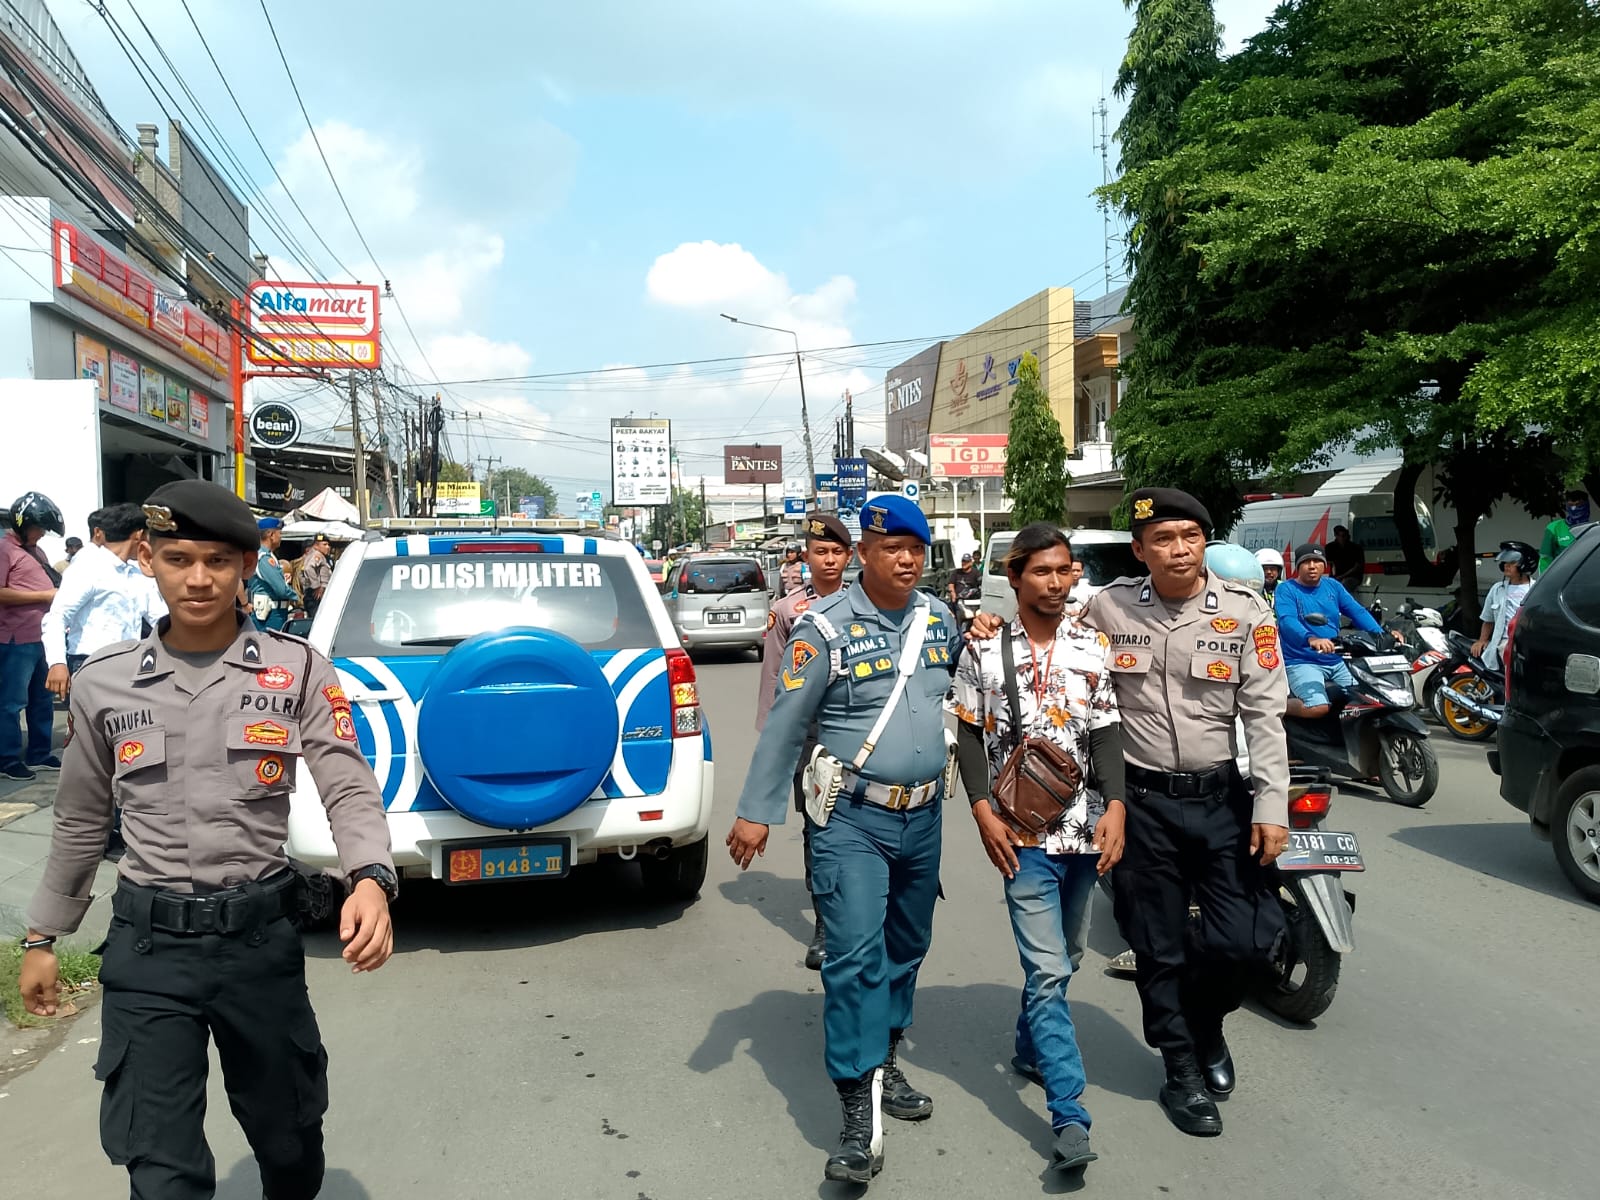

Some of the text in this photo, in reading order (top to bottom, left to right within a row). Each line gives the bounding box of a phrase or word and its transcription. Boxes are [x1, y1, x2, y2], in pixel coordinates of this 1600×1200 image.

[259, 291, 367, 314] Alfamart
[888, 376, 922, 415] PANTES
[256, 418, 294, 432] bean!
[951, 448, 989, 461] IGD
[731, 460, 778, 470] PANTES
[391, 562, 602, 590] POLISI MILITER
[936, 629, 946, 639] AL
[1111, 634, 1151, 646] SUTARJO
[878, 636, 886, 648] S
[485, 859, 530, 876] 9148
[546, 856, 561, 872] III
